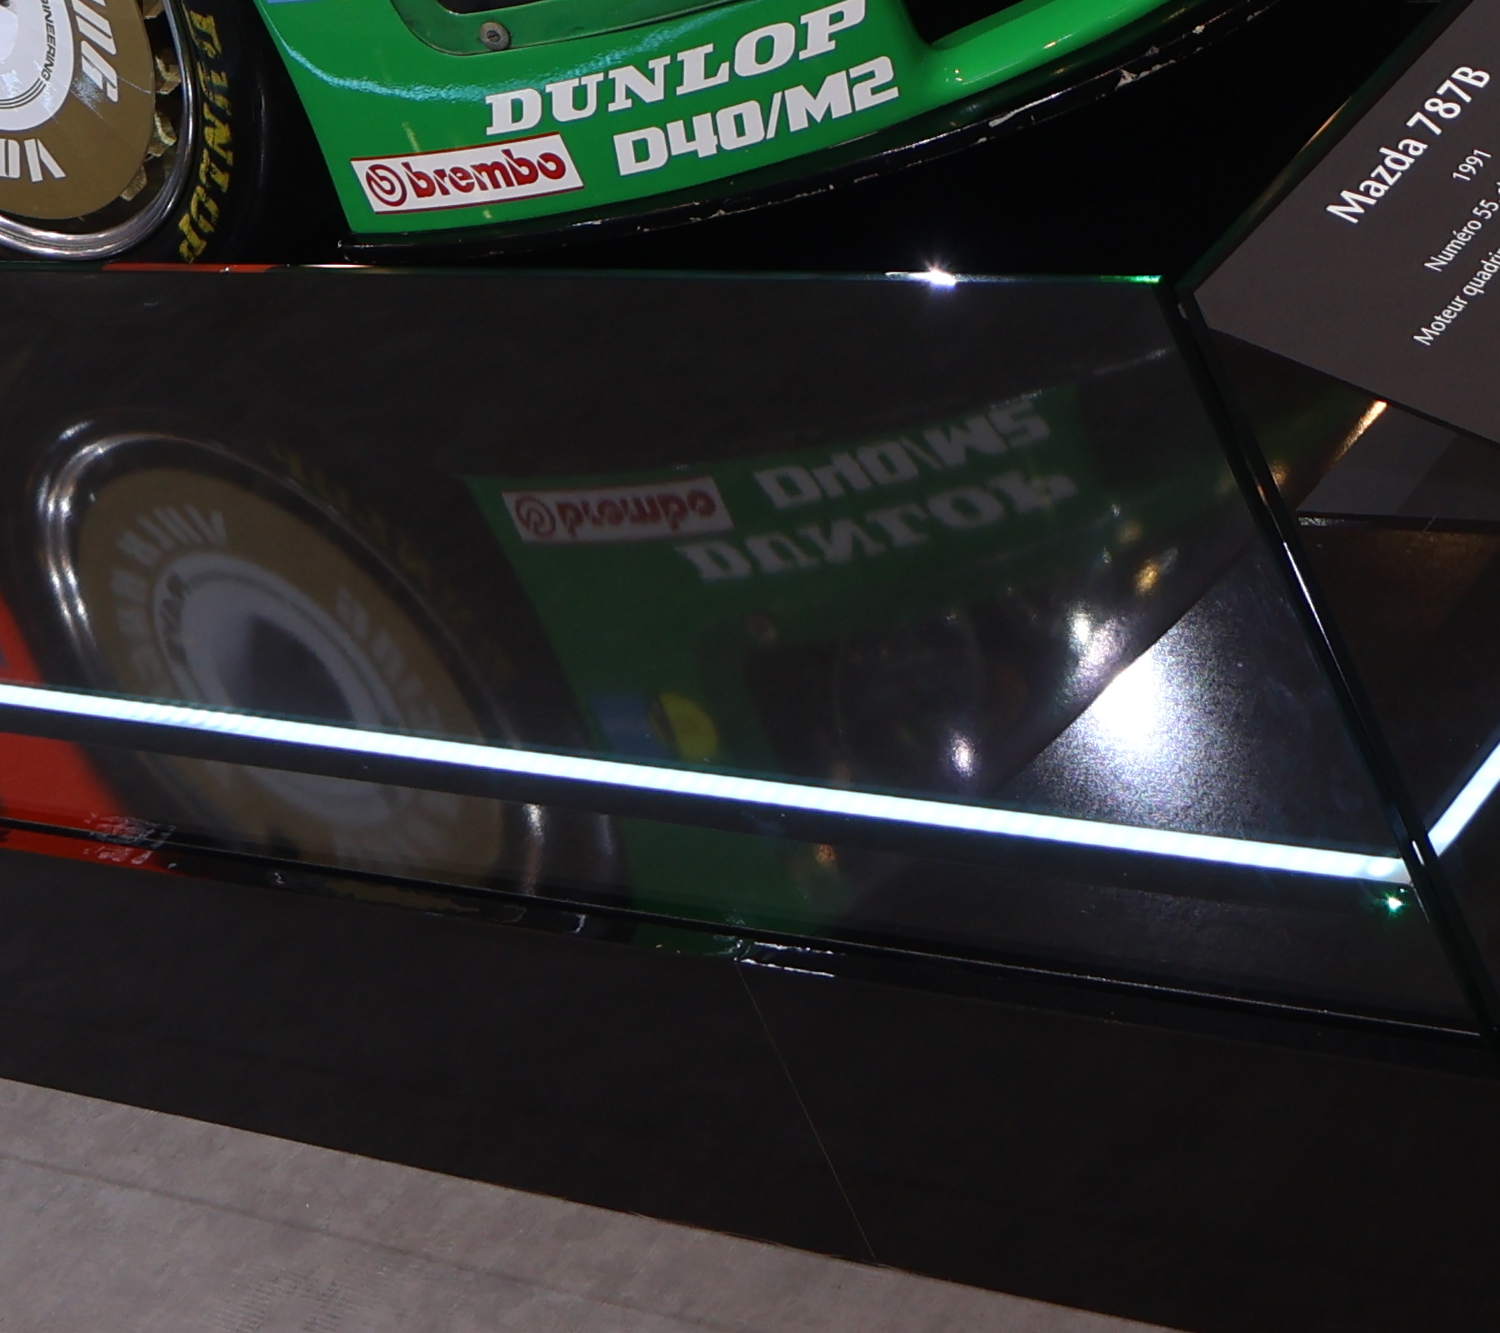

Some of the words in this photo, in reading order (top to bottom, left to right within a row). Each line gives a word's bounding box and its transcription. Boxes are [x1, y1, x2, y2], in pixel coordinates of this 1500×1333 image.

[613, 54, 900, 179] D40/M2
[1326, 138, 1428, 223] Mazda
[1406, 66, 1490, 135] 787B
[410, 143, 568, 207] brembo
[1452, 149, 1491, 181] 1991
[1423, 220, 1482, 272] Numéro
[1413, 295, 1468, 346] Moteur
